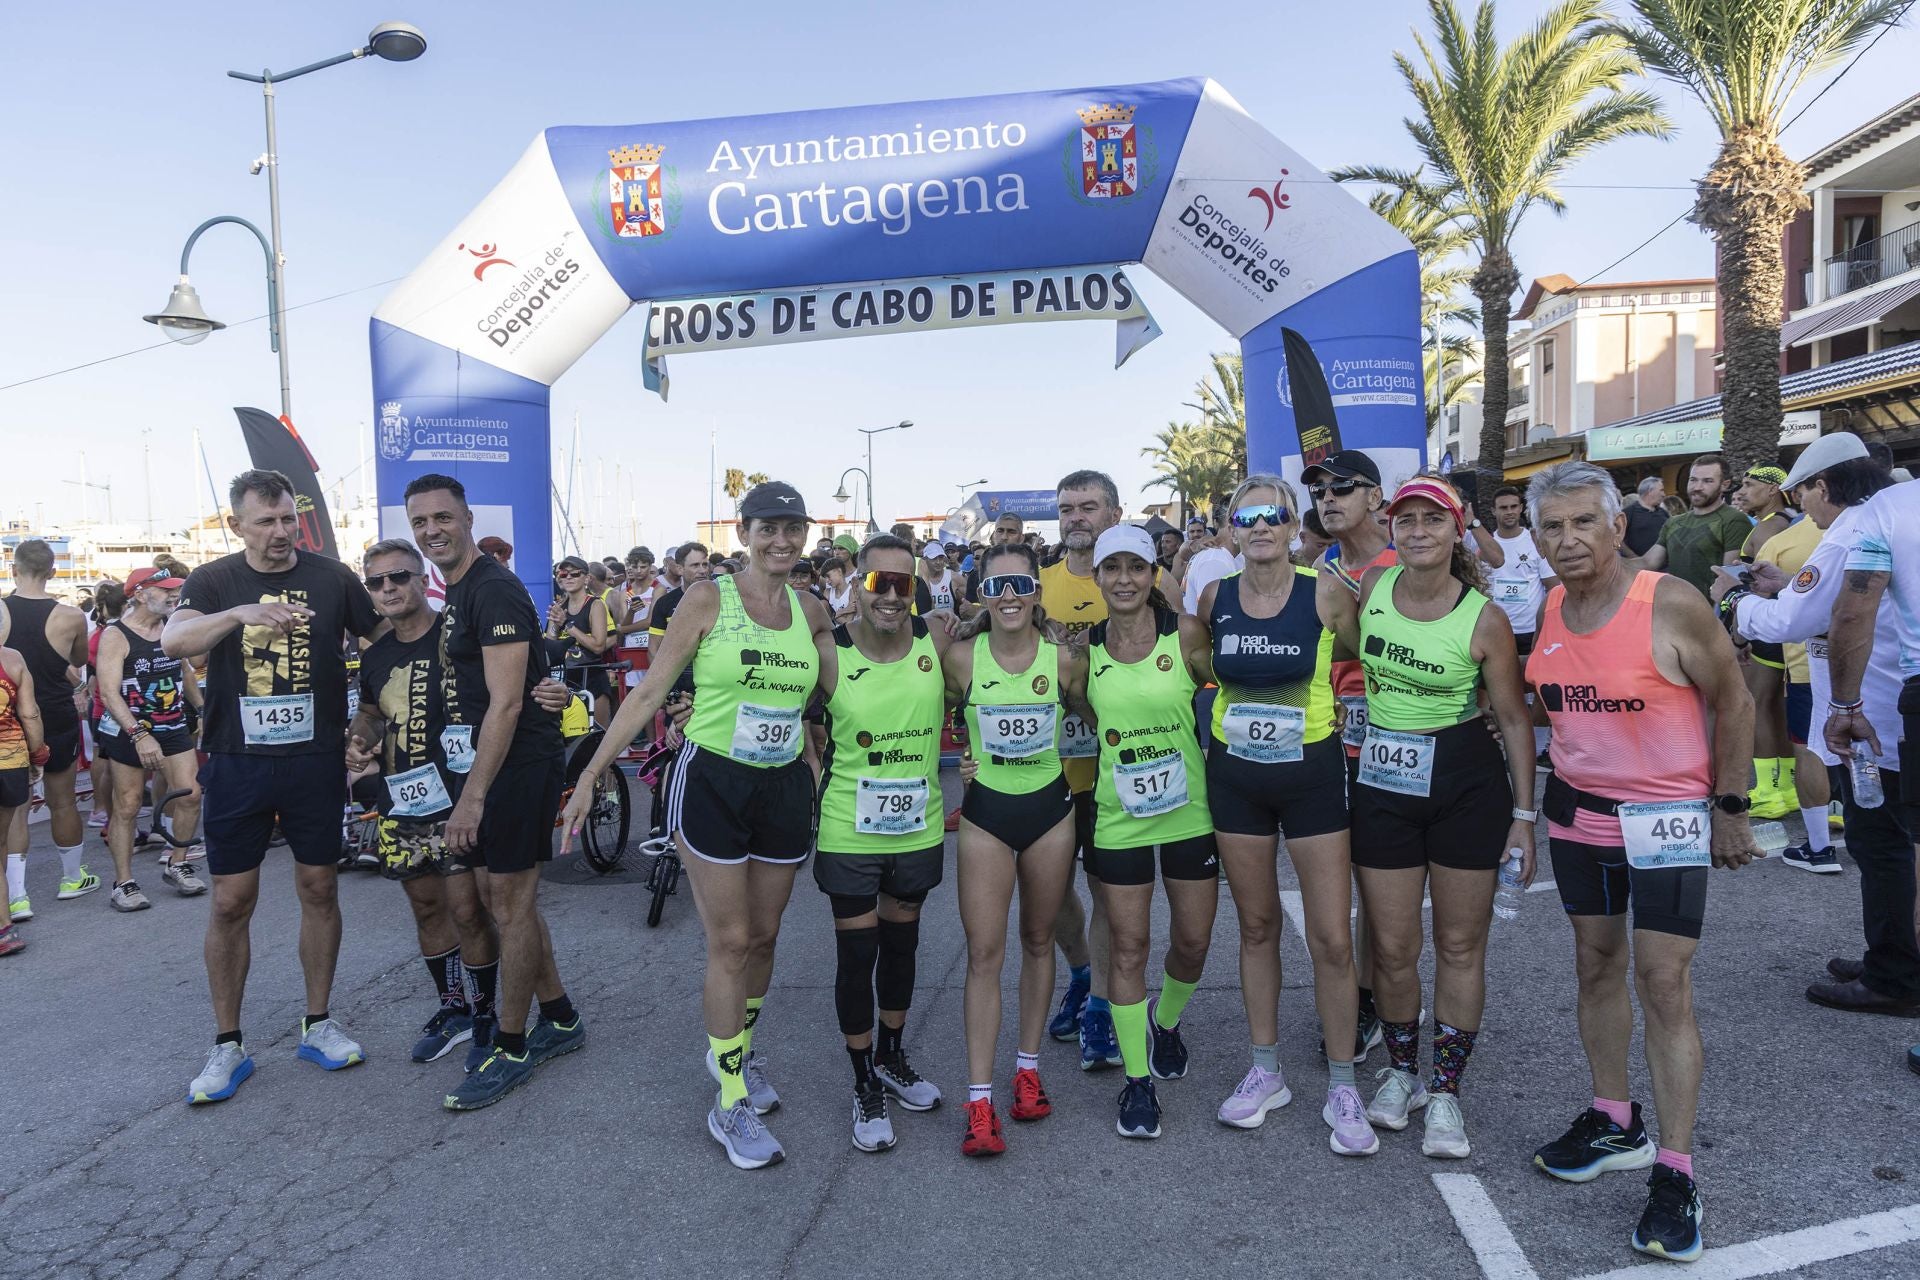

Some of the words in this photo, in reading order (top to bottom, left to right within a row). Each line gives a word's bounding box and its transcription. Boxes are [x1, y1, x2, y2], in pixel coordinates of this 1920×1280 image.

[706, 121, 1027, 180] Ayuntamiento
[708, 171, 1029, 235] Cartagena
[1193, 194, 1268, 261] Concejalía
[1269, 258, 1290, 278] de
[1178, 205, 1278, 293] Deportes
[1171, 226, 1217, 265] AYUNTAMIENTO
[1218, 264, 1227, 273] DE
[1228, 273, 1264, 303] CARTAGENA
[477, 267, 545, 332] Concejalía
[545, 246, 564, 266] de
[487, 258, 580, 347] Deportes
[648, 300, 756, 348] CROSS
[772, 295, 816, 335] DE
[831, 286, 934, 329] CABO
[951, 281, 996, 319] DE
[1012, 272, 1133, 314] PALOS
[1331, 358, 1415, 373] Ayuntamiento
[1332, 373, 1416, 391] Cartagena
[1351, 393, 1415, 404] www.cartagena.es
[414, 415, 508, 430] Ayuntamiento
[414, 429, 509, 449] Cartagena
[1605, 434, 1624, 447] LA
[1633, 431, 1668, 445] OLA
[1675, 428, 1711, 441] BAR
[430, 450, 507, 461] www.cartagena.es
[1004, 496, 1051, 505] Ayuntamiento
[1004, 503, 1051, 513] Cartagena
[1505, 585, 1518, 594] 26
[493, 624, 516, 637] HUN
[1241, 635, 1268, 648] pan
[1242, 644, 1301, 656] moreno
[1387, 642, 1415, 658] pan
[762, 651, 785, 661] pan
[766, 659, 809, 670] moreno
[1388, 652, 1445, 675] moreno
[1564, 684, 1597, 704] pan
[410, 660, 431, 766] FARKASFAL
[1568, 698, 1645, 713] moreno
[254, 707, 305, 725] 1435
[1348, 708, 1369, 725] 15
[756, 723, 792, 743] 396
[873, 727, 933, 742] CARRILSOLAR
[998, 718, 1039, 736] 983
[1121, 723, 1182, 739] CARRILSOLAR
[1249, 721, 1276, 741] 62
[884, 749, 903, 760] pan
[886, 754, 923, 764] moreno
[1136, 745, 1156, 757] pan
[1140, 747, 1178, 761] moreno
[1370, 743, 1419, 769] 1043
[1134, 770, 1169, 795] 517
[1411, 772, 1426, 781] CAL
[400, 782, 428, 801] 626
[877, 795, 912, 813] 798
[1651, 817, 1701, 840] 464
